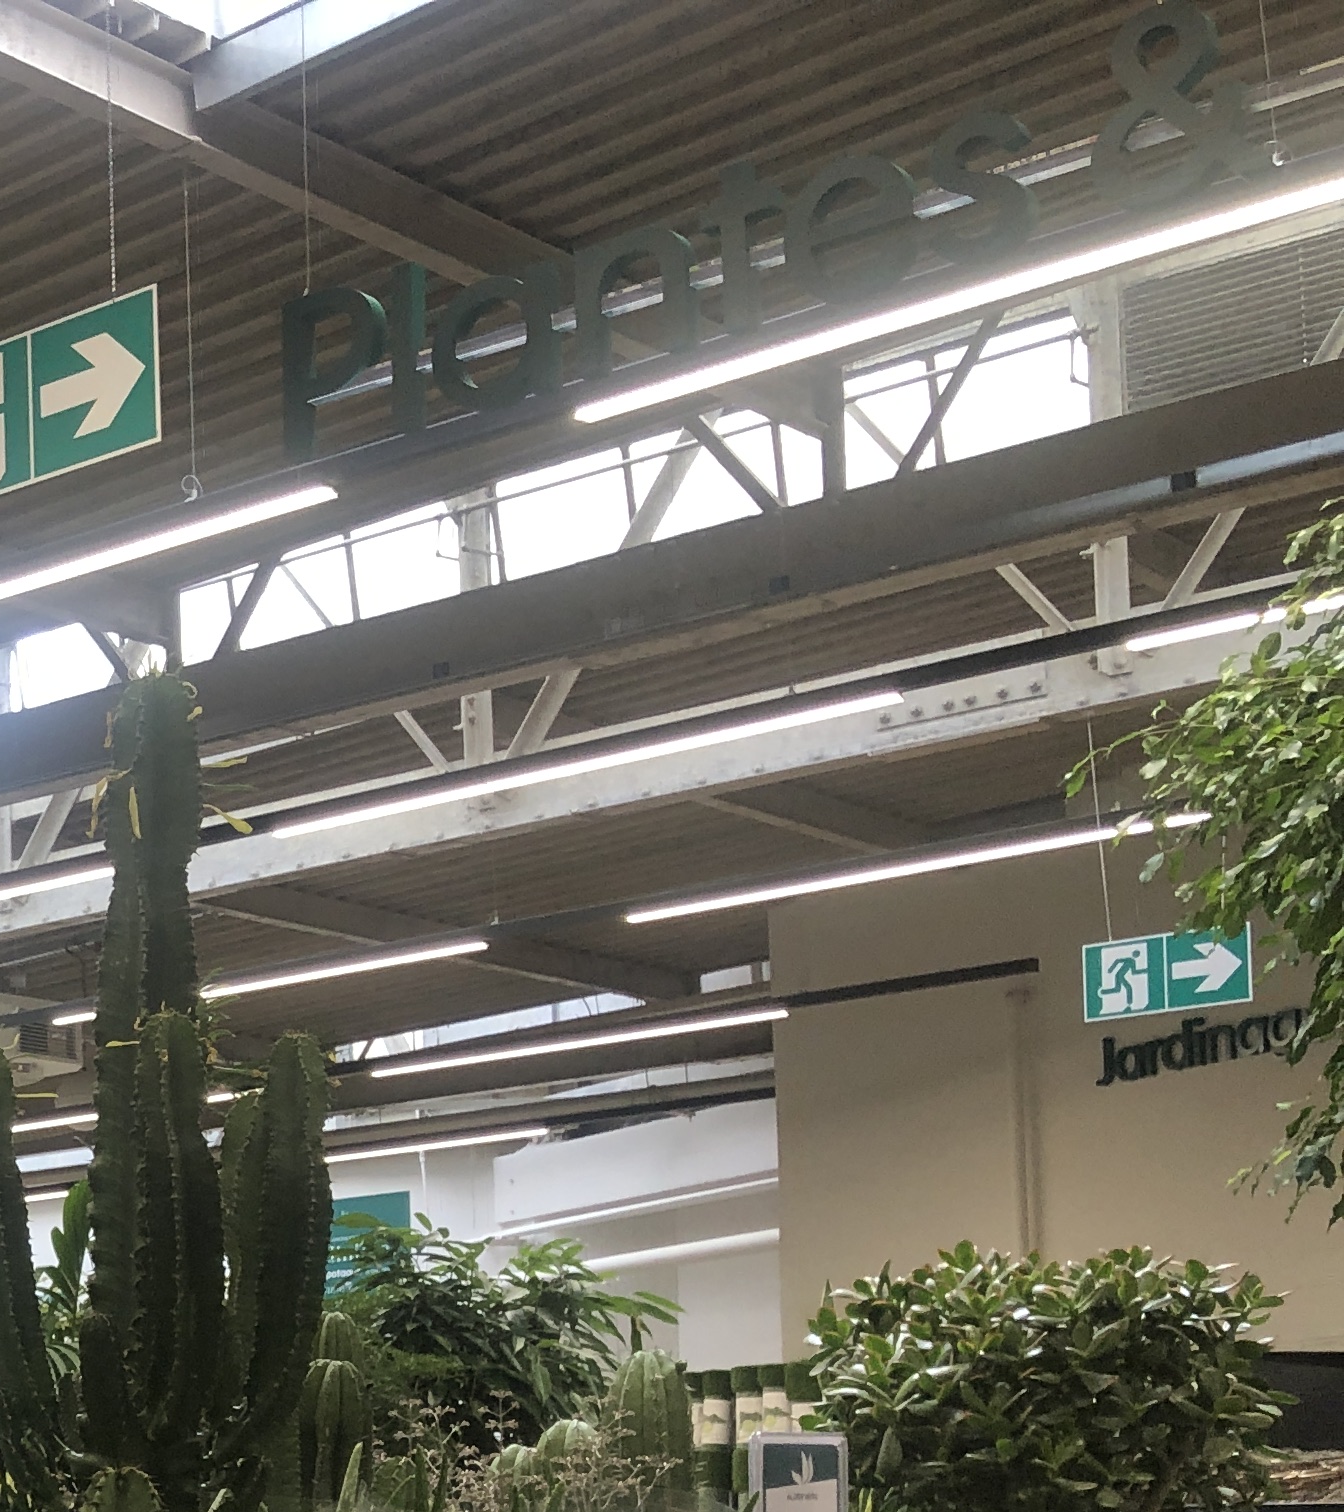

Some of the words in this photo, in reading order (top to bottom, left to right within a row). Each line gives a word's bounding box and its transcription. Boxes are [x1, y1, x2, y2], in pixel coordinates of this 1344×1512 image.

[283, 112, 1039, 462] plantes
[1092, 2, 1274, 208] &
[1096, 1008, 1306, 1086] Jardinag
